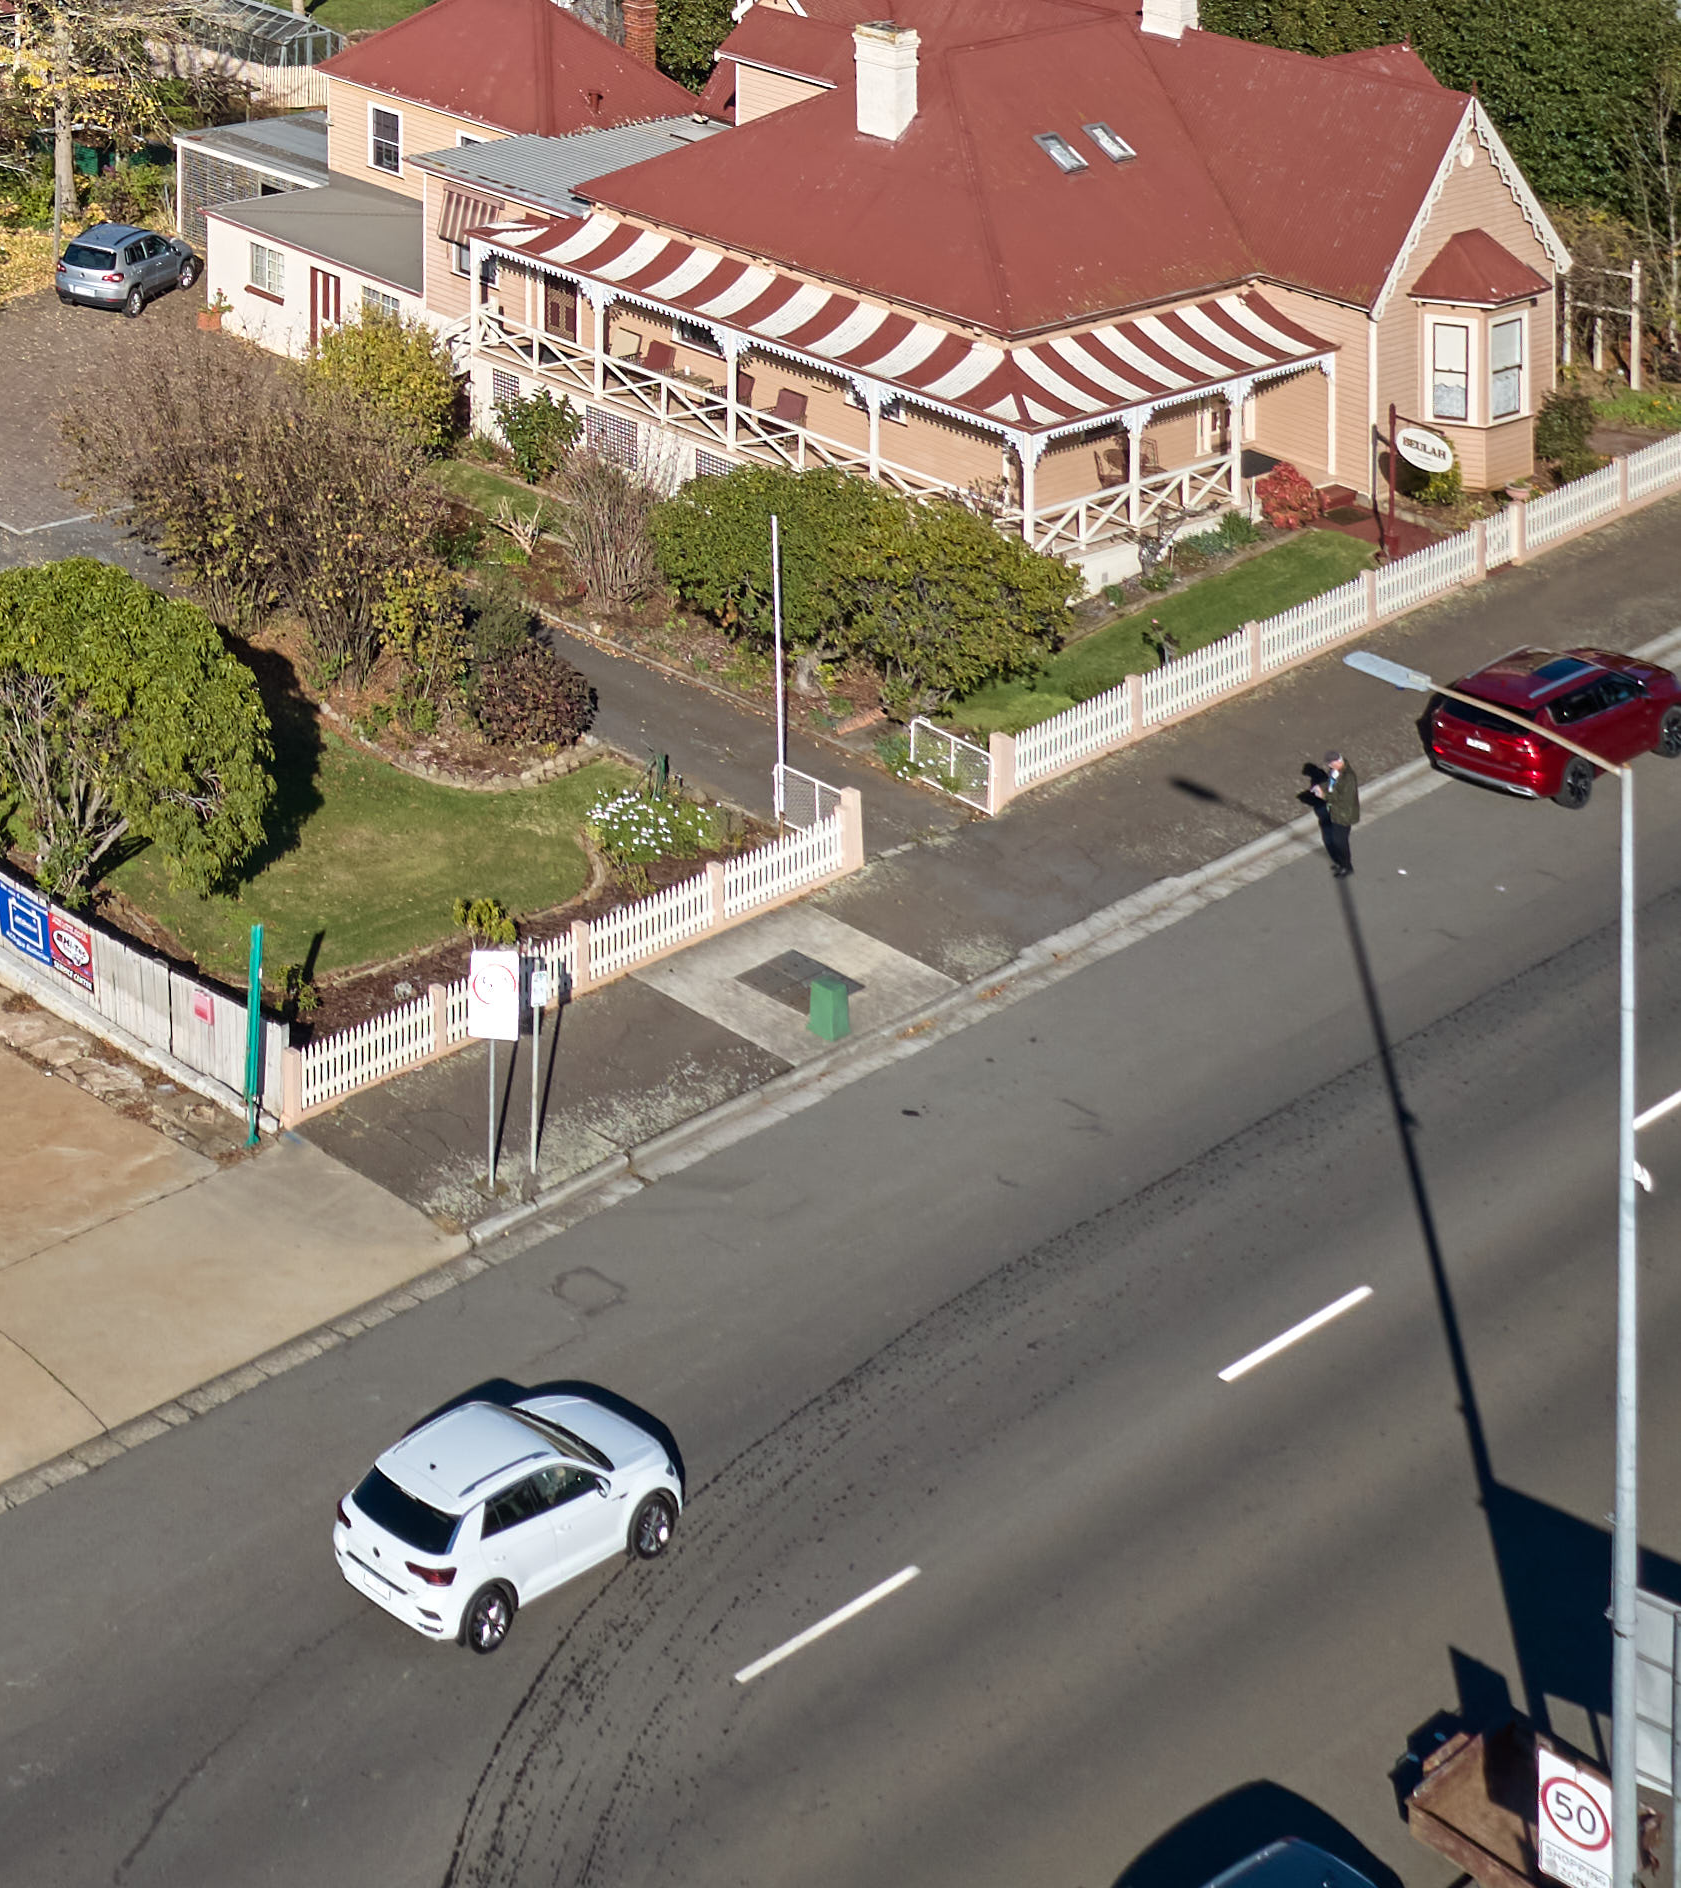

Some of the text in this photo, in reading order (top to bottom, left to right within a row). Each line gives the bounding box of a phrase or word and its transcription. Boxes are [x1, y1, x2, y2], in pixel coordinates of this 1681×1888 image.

[1403, 437, 1446, 460] BEULAH
[1555, 1791, 1596, 1835] 50
[1544, 1845, 1608, 1888] SHOPPING
